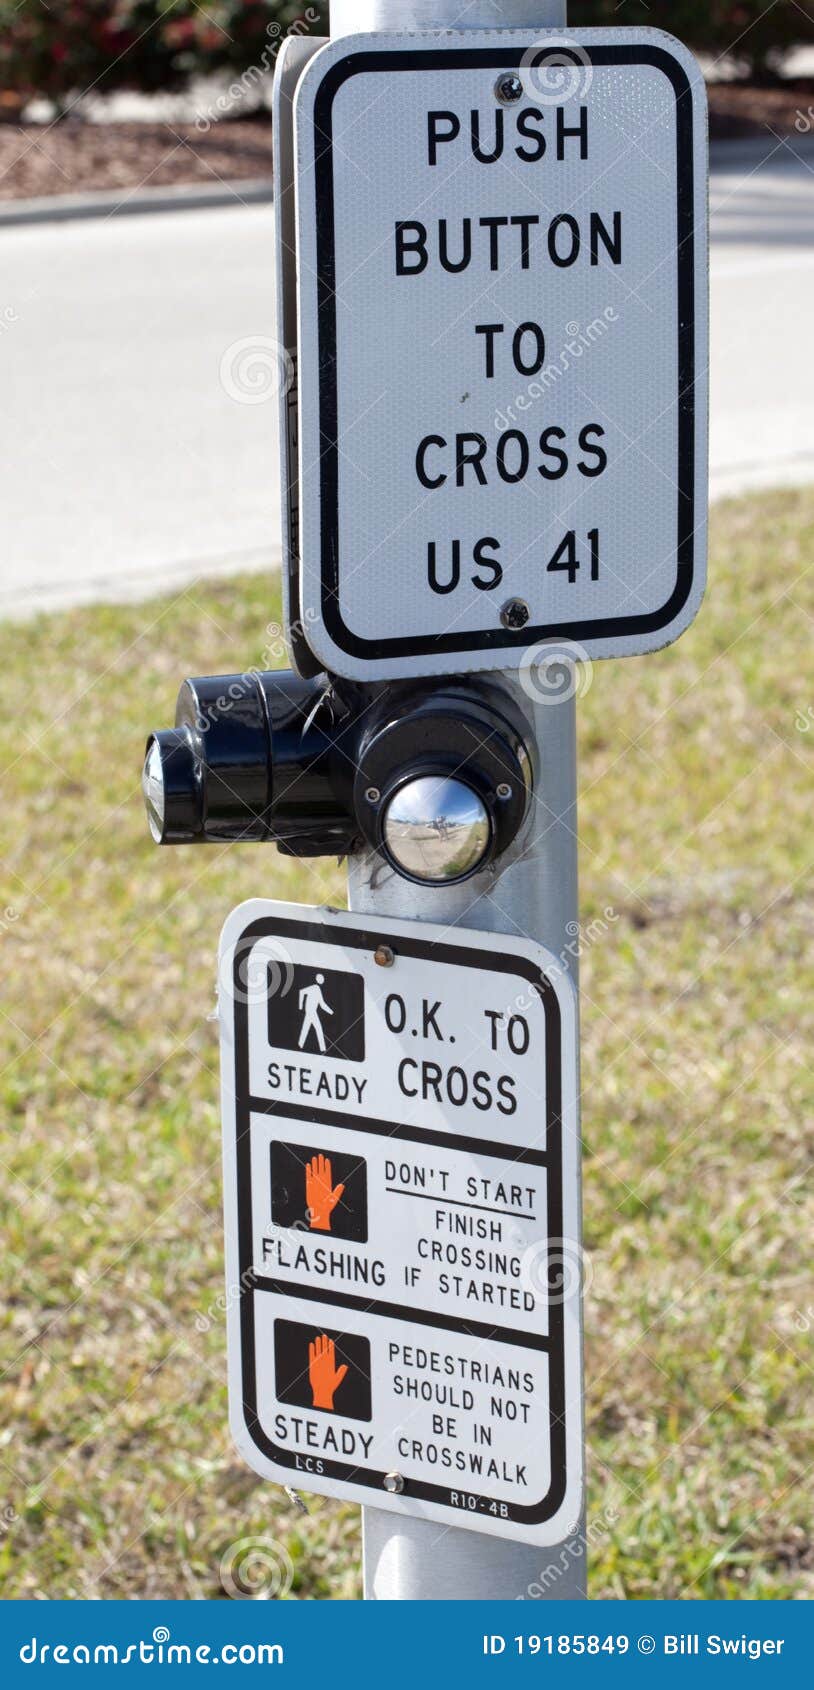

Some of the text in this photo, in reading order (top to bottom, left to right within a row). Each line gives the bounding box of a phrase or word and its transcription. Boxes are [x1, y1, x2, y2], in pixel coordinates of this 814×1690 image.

[426, 106, 590, 166] PUSH
[394, 211, 623, 276] BUTTON
[475, 321, 546, 378] TO
[415, 423, 609, 489] CROSS
[426, 528, 601, 594] US 41
[384, 993, 530, 1055] O.K. TO
[267, 1062, 368, 1104] STEADY
[398, 1057, 517, 1115] CROSS
[384, 1160, 536, 1209] DON'T START
[435, 1210, 502, 1242] FINISH
[261, 1237, 386, 1287] FLASHING
[417, 1238, 521, 1278] CROSSING
[404, 1266, 535, 1312] IF STARTED
[388, 1342, 535, 1393] PEDESTRIANS
[392, 1375, 531, 1424] SHOULD NOT
[274, 1414, 374, 1459] STEADY
[432, 1414, 492, 1446] BE IN
[294, 1456, 325, 1475] LCS
[398, 1437, 529, 1486] CROSSWALK
